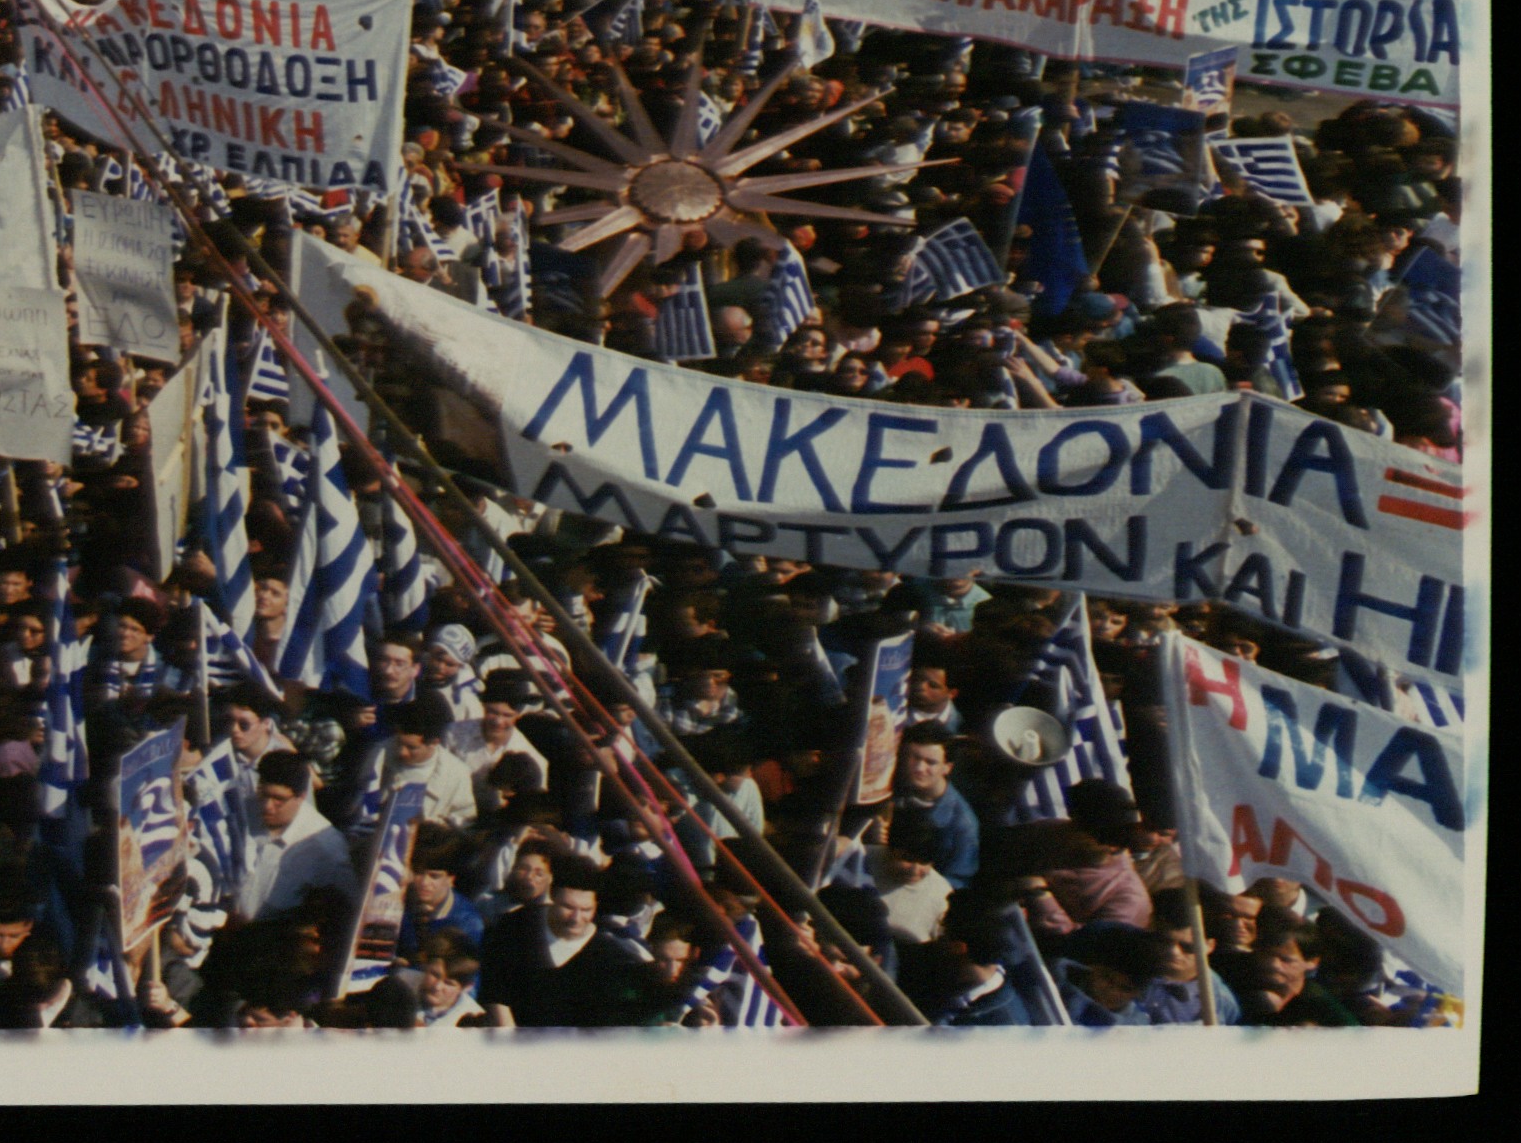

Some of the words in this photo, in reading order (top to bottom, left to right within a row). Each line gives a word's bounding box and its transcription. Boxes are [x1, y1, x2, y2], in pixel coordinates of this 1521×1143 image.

[144, 33, 378, 104] ΟΡΘΟΔΟΞΗ
[1249, 54, 1441, 97] ΣΦΕΒΑ
[225, 142, 388, 192] ΕΛΠΙΔΑ
[521, 353, 1370, 529] ΜΑΚΕΔΟΝΙΑ
[532, 461, 1148, 584] ΜΑΡΤΥΡΟΝ
[1173, 540, 1307, 629] ΚΑΙ
[1183, 644, 1248, 731] Η
[1227, 804, 1407, 938] ΑΠΟ
